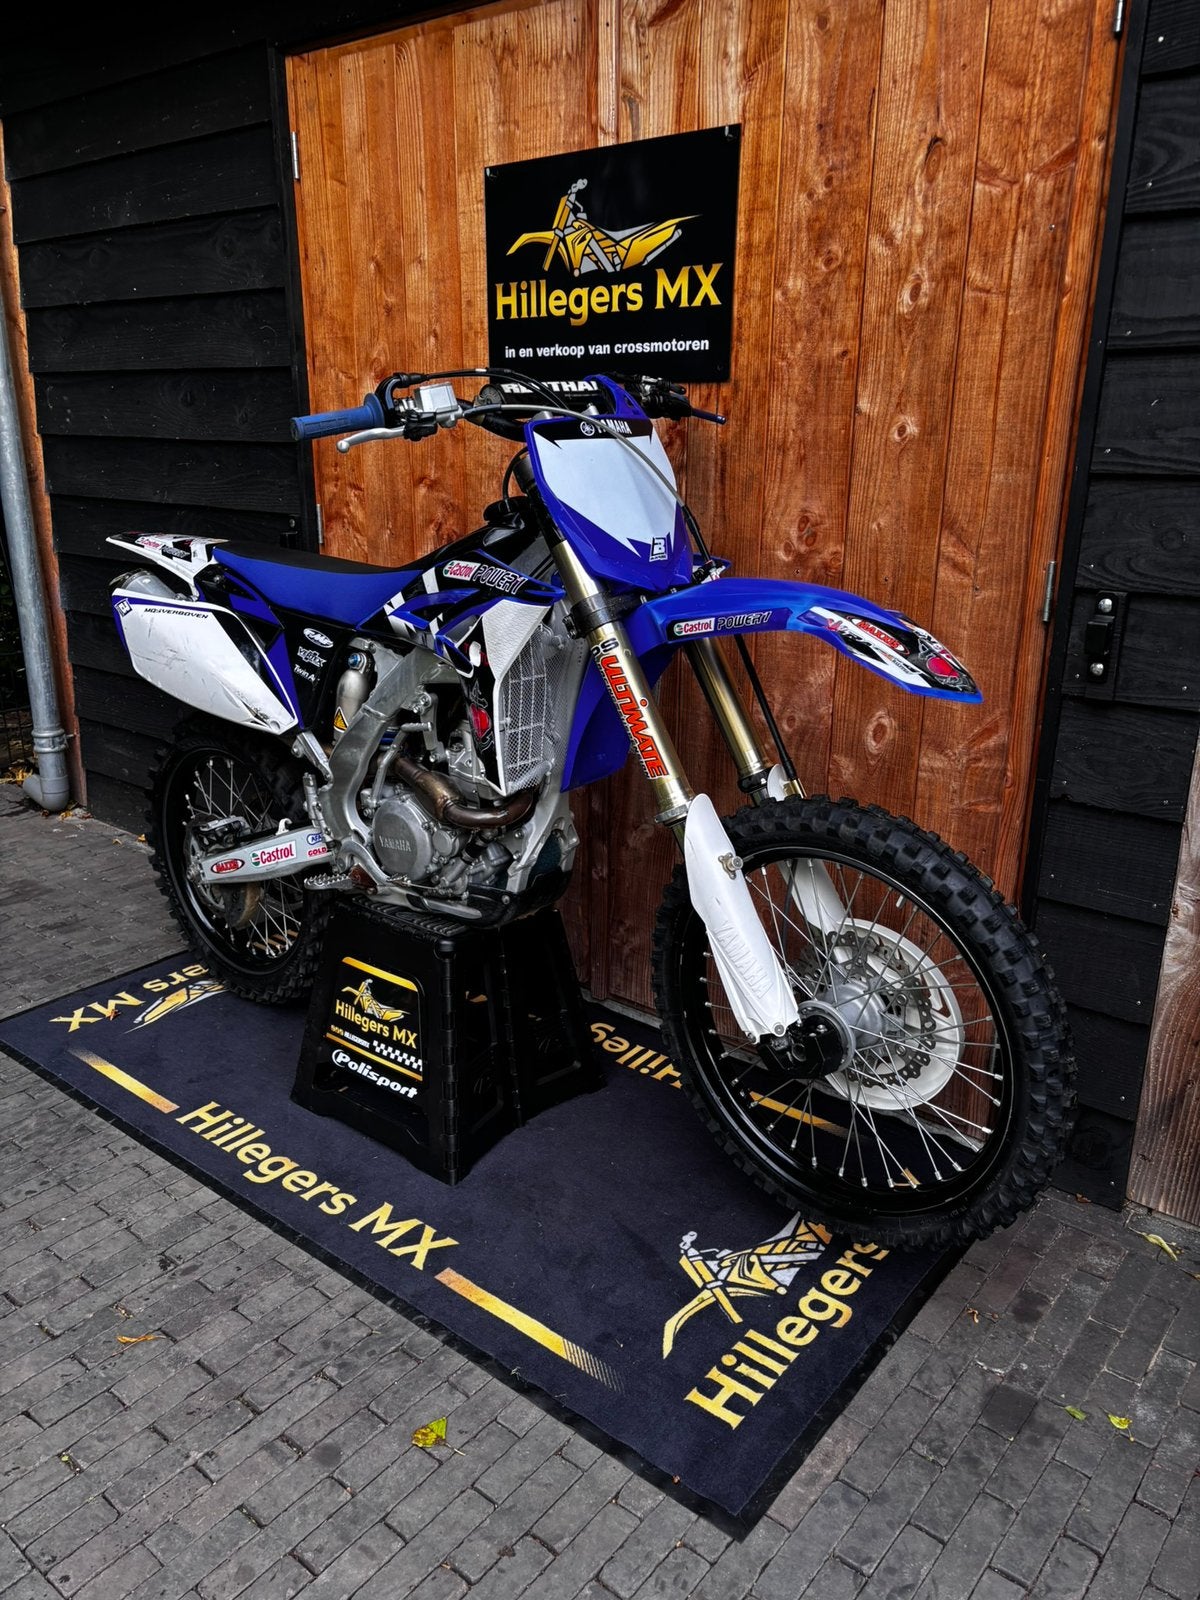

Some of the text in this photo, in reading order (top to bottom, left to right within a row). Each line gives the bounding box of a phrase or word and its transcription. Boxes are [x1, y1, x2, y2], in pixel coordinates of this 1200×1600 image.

[494, 263, 724, 326] Hillegers MX
[504, 338, 710, 358] in en verkoop van crossmotoren
[500, 381, 599, 394] RETHA
[683, 620, 712, 633] Castrol
[857, 619, 901, 650] MAXXIS
[294, 663, 310, 679] Twin
[600, 654, 669, 779] ULTIMATE
[260, 844, 295, 865] Castrol
[307, 847, 327, 857] GOLD
[379, 835, 412, 852] YAMAHA
[713, 920, 775, 1000] YAMAHA
[49, 991, 146, 1033] MX
[335, 999, 390, 1037] Hillegers
[392, 1025, 418, 1049] MX
[336, 1052, 418, 1099] Polisport
[175, 1101, 459, 1270] Hillegers MX
